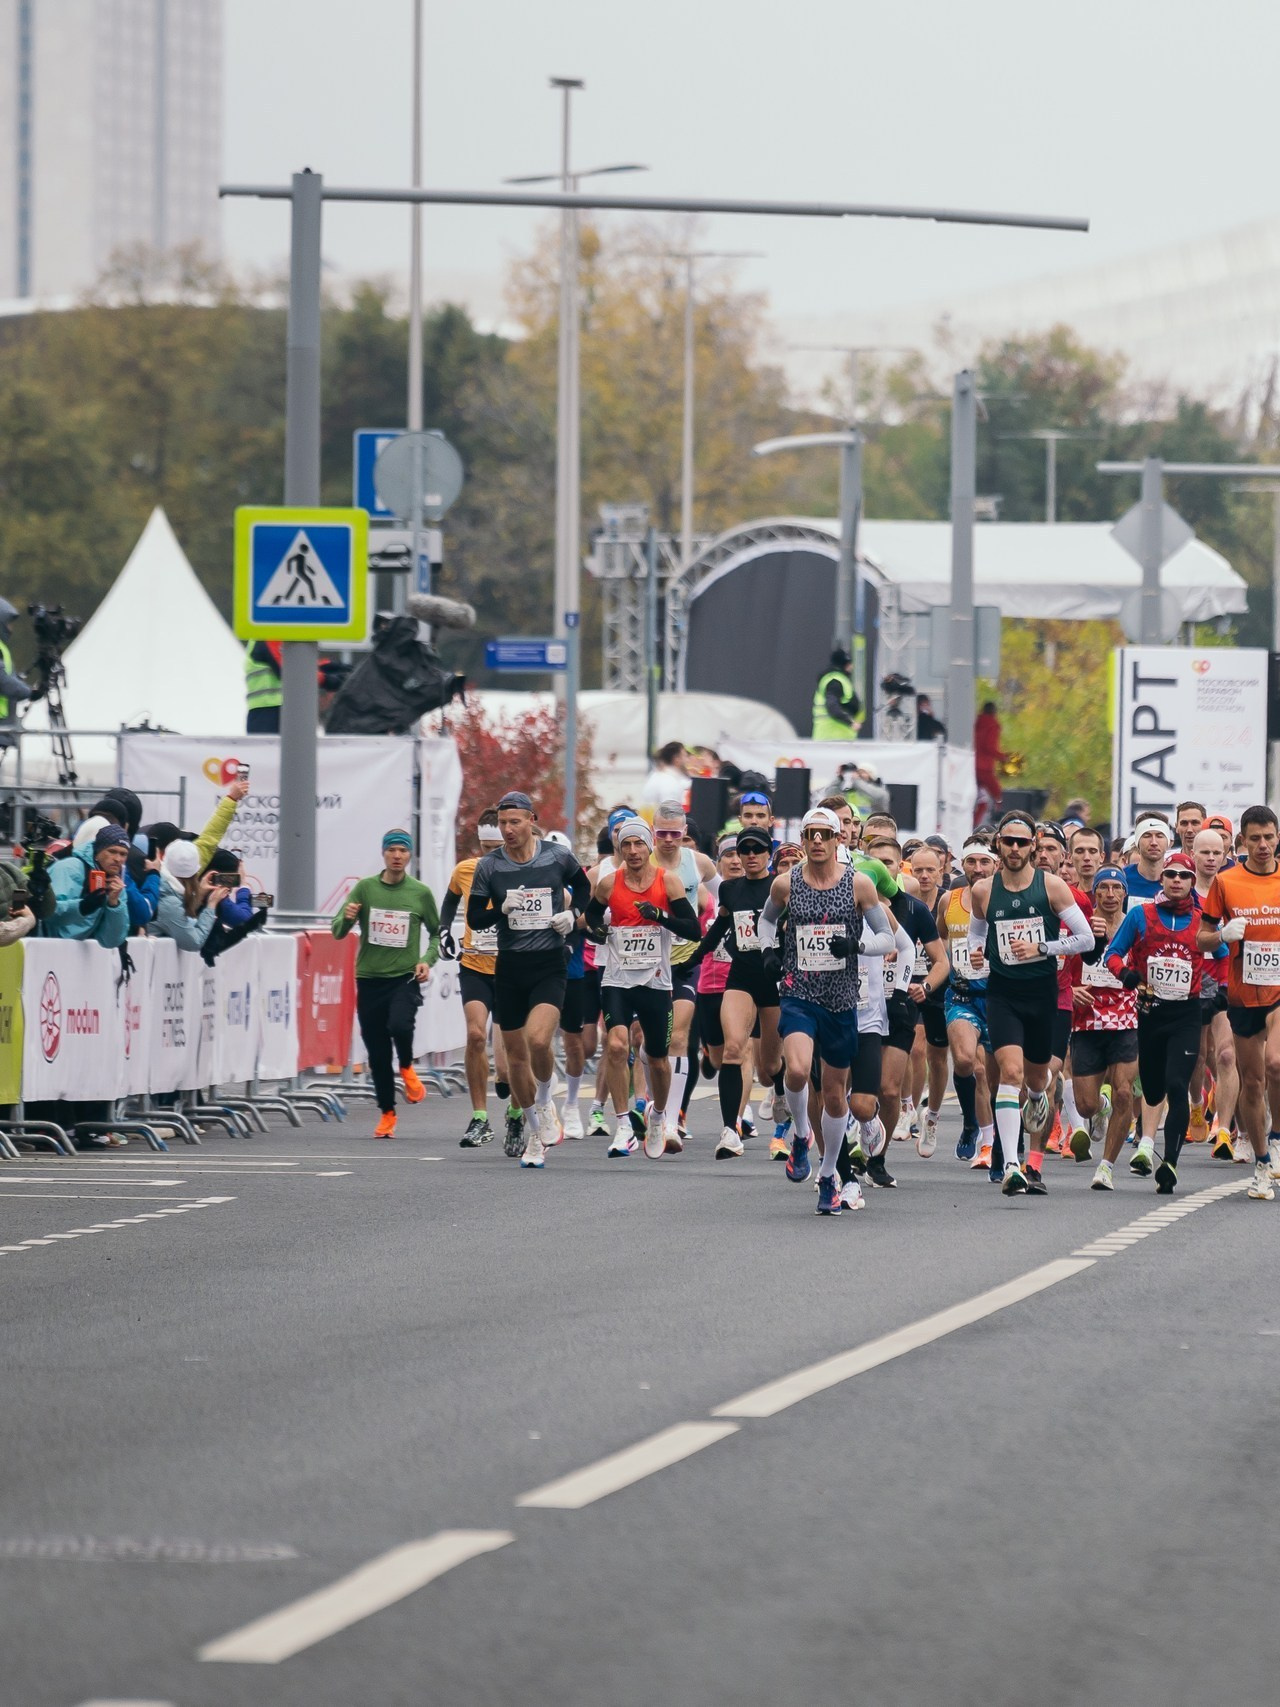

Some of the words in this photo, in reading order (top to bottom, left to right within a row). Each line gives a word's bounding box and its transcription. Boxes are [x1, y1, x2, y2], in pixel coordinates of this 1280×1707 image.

[1130, 660, 1178, 827] ТАРТ
[1232, 907, 1259, 916] Team
[371, 921, 406, 935] 17361
[623, 938, 655, 952] 2776
[1149, 966, 1190, 984] 15713
